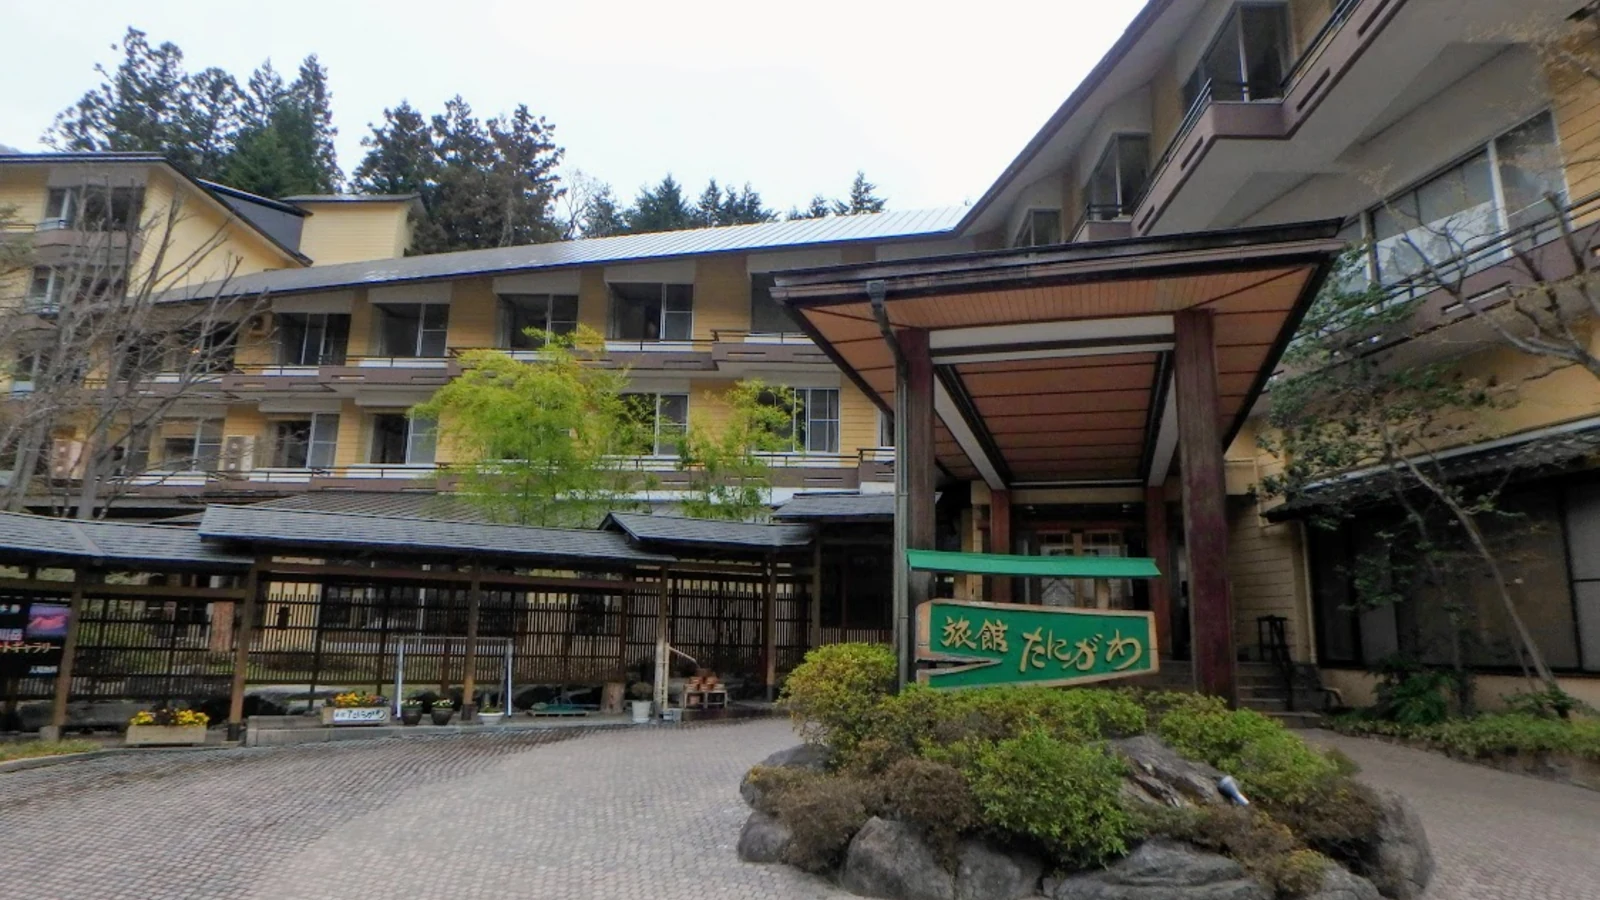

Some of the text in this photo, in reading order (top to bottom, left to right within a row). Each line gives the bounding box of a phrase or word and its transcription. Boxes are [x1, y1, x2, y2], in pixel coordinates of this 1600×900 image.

[940, 615, 1142, 673] 旅館 たにがわ
